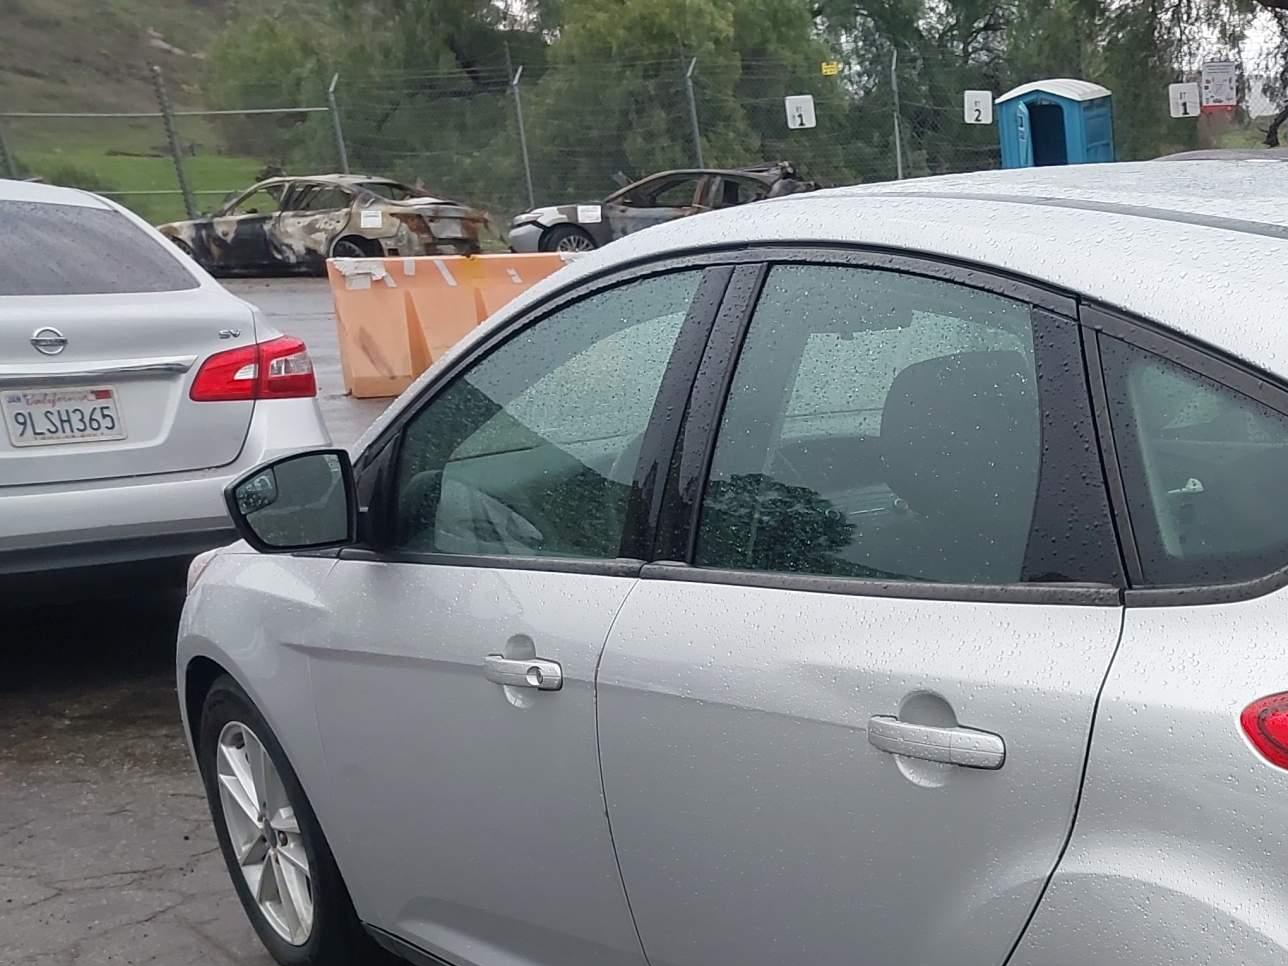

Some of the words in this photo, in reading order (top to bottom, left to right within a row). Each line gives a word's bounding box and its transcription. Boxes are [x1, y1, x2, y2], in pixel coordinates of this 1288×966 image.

[973, 108, 983, 122] 2
[1181, 101, 1190, 115] 1
[797, 113, 806, 127] 1
[218, 328, 241, 340] SV
[14, 405, 116, 437] 9LSH365
